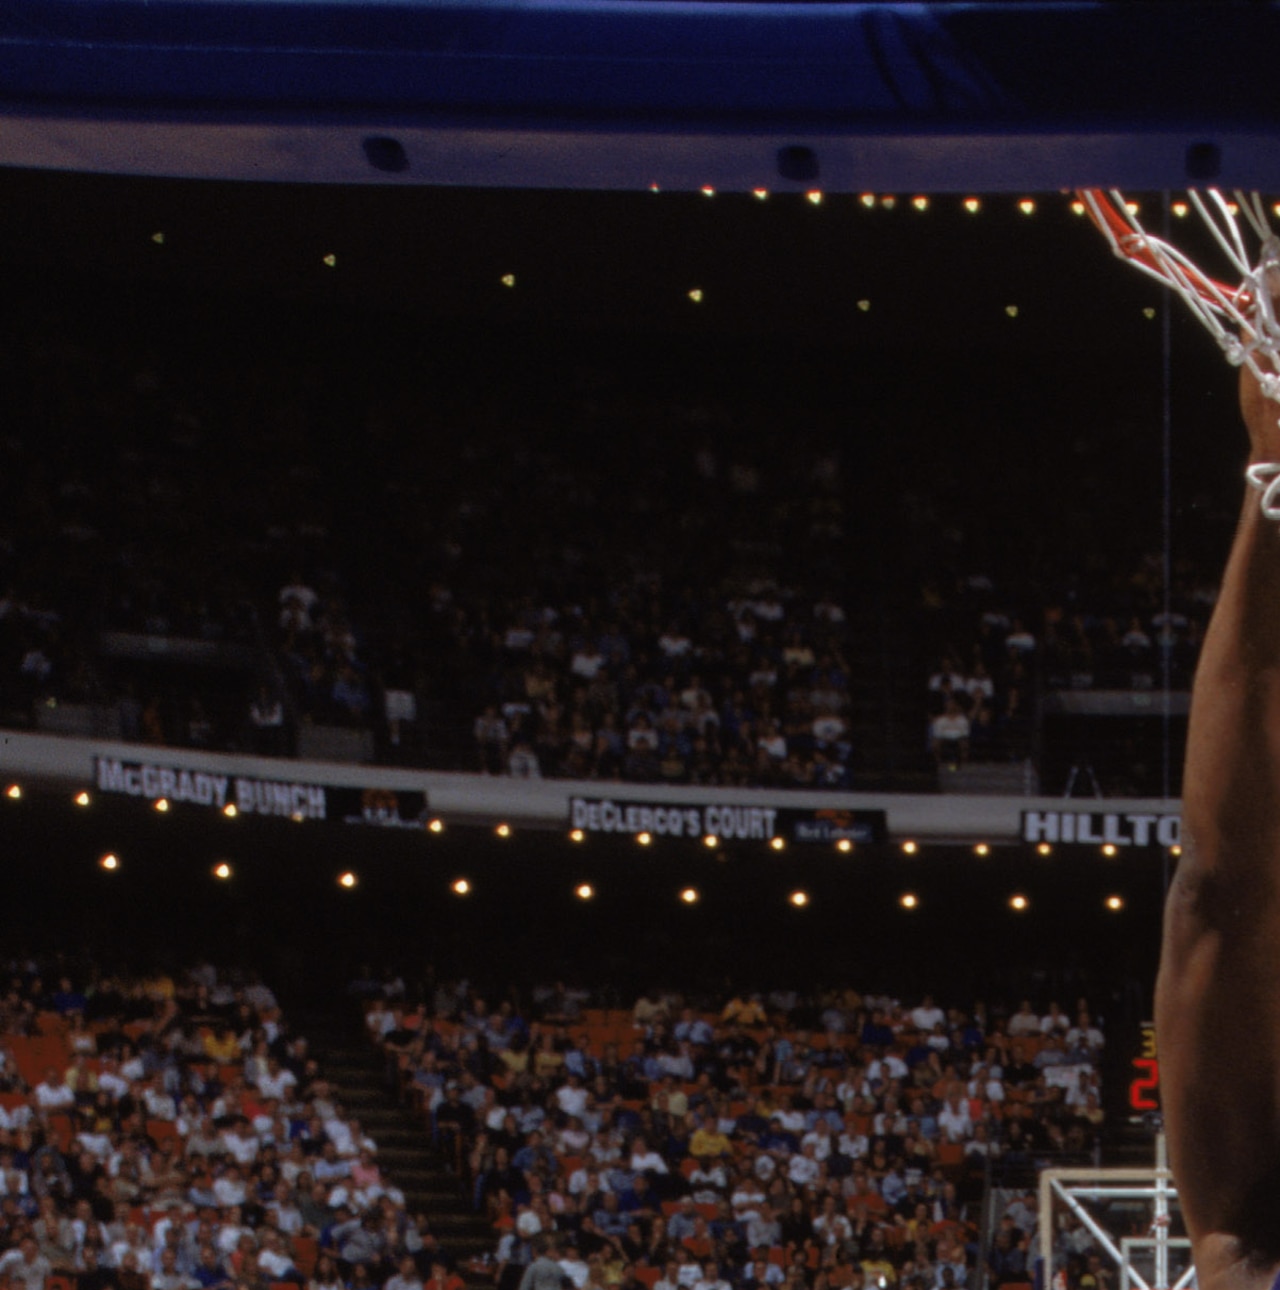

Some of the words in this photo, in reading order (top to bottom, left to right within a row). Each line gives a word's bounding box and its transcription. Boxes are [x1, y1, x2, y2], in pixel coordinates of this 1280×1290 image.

[235, 779, 326, 820] BUNCH
[705, 806, 777, 839] COURT
[1130, 1058, 1160, 1110] 2
